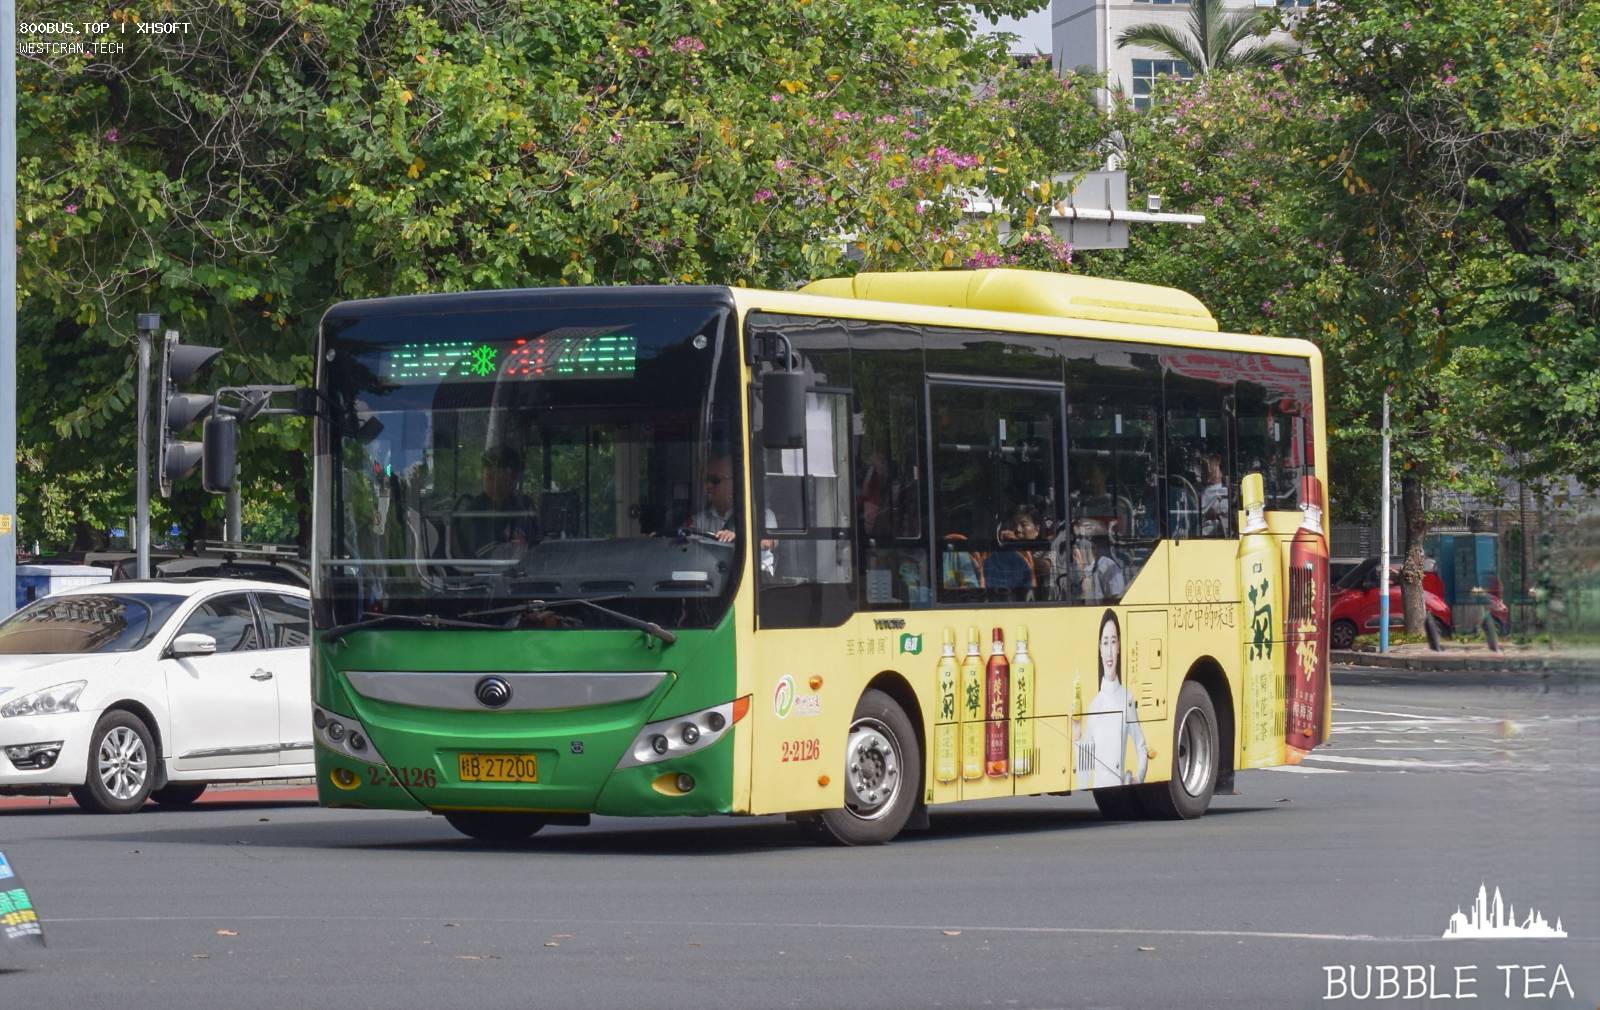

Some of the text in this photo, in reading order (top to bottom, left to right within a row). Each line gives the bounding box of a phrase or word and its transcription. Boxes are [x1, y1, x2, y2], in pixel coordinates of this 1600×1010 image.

[1172, 603, 1235, 632] 记忆中的味道
[782, 738, 820, 762] 2-2126
[367, 766, 437, 789] 2-2126
